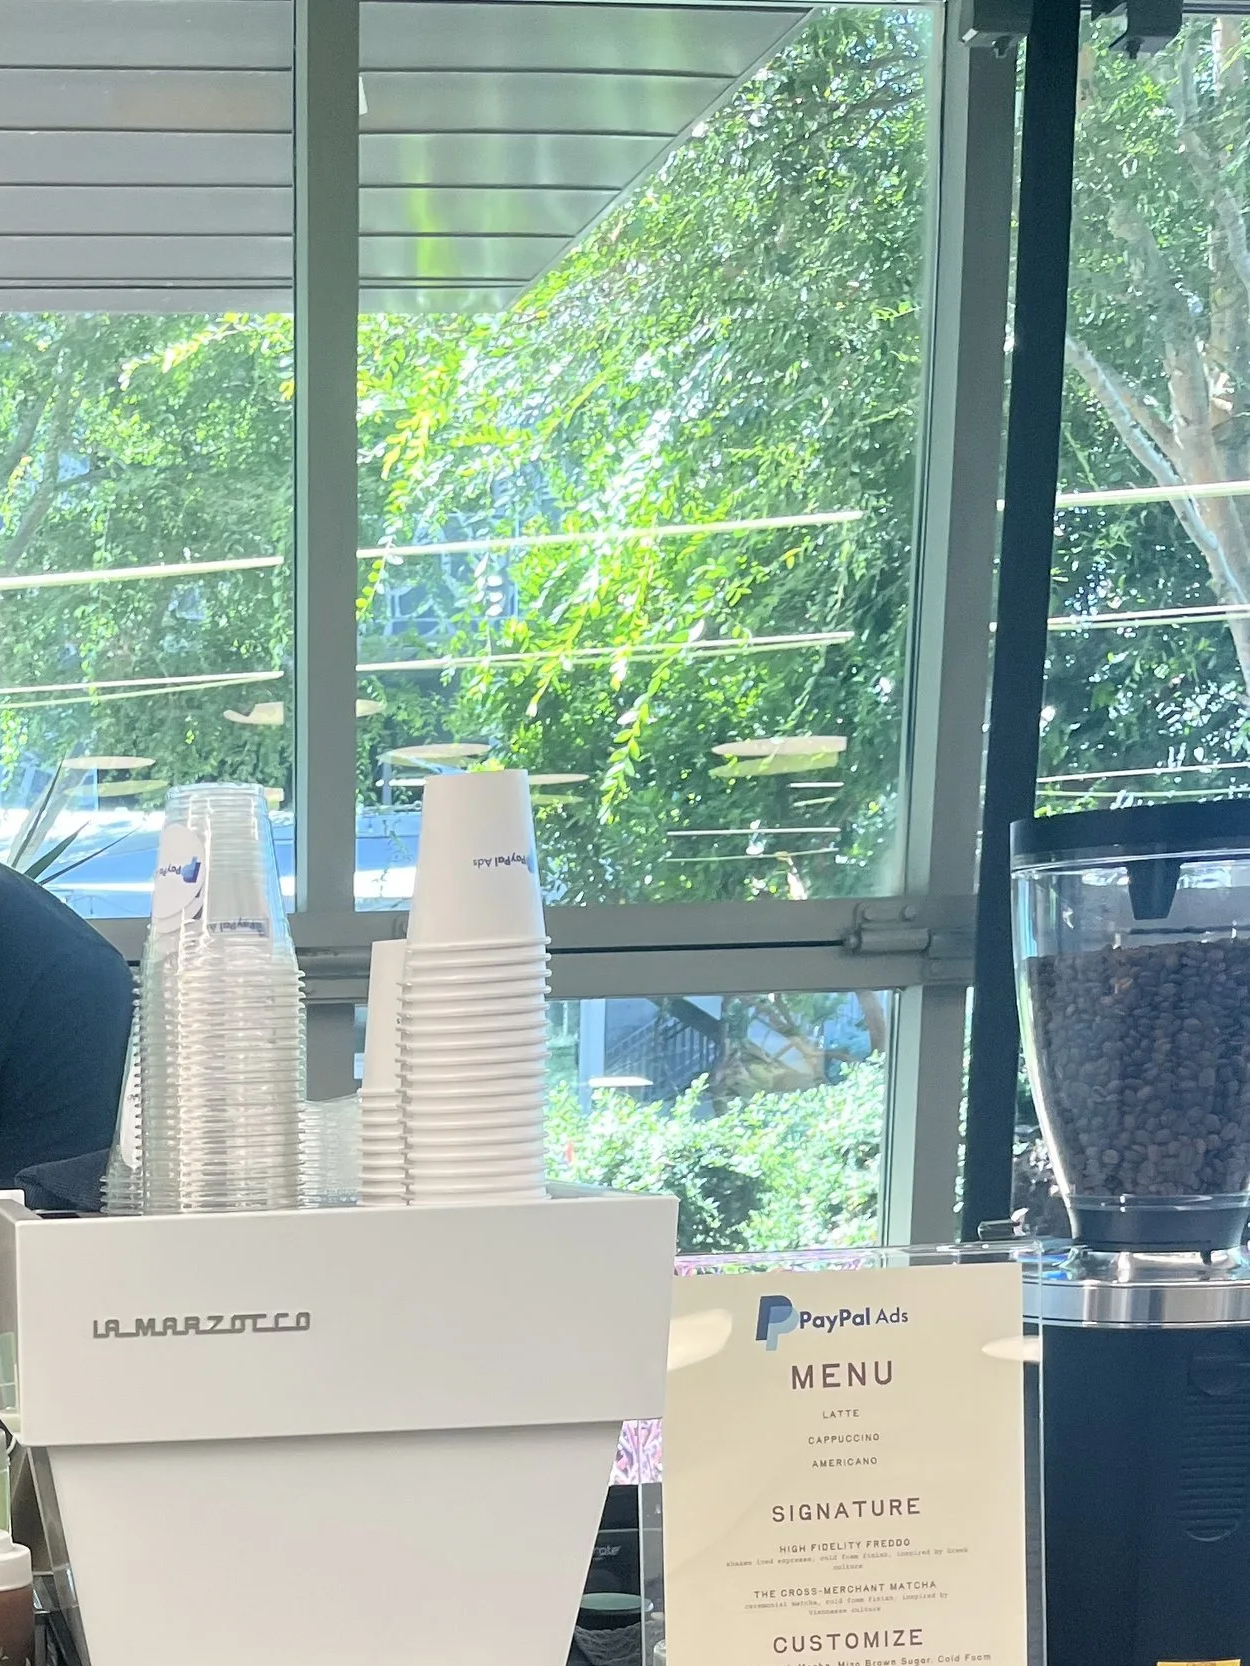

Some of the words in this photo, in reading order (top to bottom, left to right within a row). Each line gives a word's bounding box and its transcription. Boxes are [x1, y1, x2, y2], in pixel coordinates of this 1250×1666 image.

[473, 858, 492, 869] Ads
[494, 852, 527, 867] PayPal
[93, 1319, 120, 1339] LA
[135, 1312, 311, 1337] MARZOCCO
[799, 1307, 871, 1333] PayPal
[875, 1307, 908, 1324] Ads
[791, 1360, 892, 1390] MENU
[822, 1409, 860, 1419] LATTE
[808, 1433, 880, 1445] CAPPUCCINO
[812, 1457, 878, 1468] AMERICANO
[772, 1497, 921, 1523] SIGNATURE
[779, 1544, 806, 1553] HIGH
[811, 1541, 861, 1552] FIDELITY
[866, 1538, 910, 1549] FREDDO
[754, 1590, 776, 1599] THE
[780, 1583, 885, 1597] CROSS-MERCHANT
[889, 1581, 937, 1592] MATCHA
[773, 1629, 923, 1654] CUSTOMIZE
[937, 1655, 960, 1663] Cold
[965, 1653, 991, 1662] Foam
